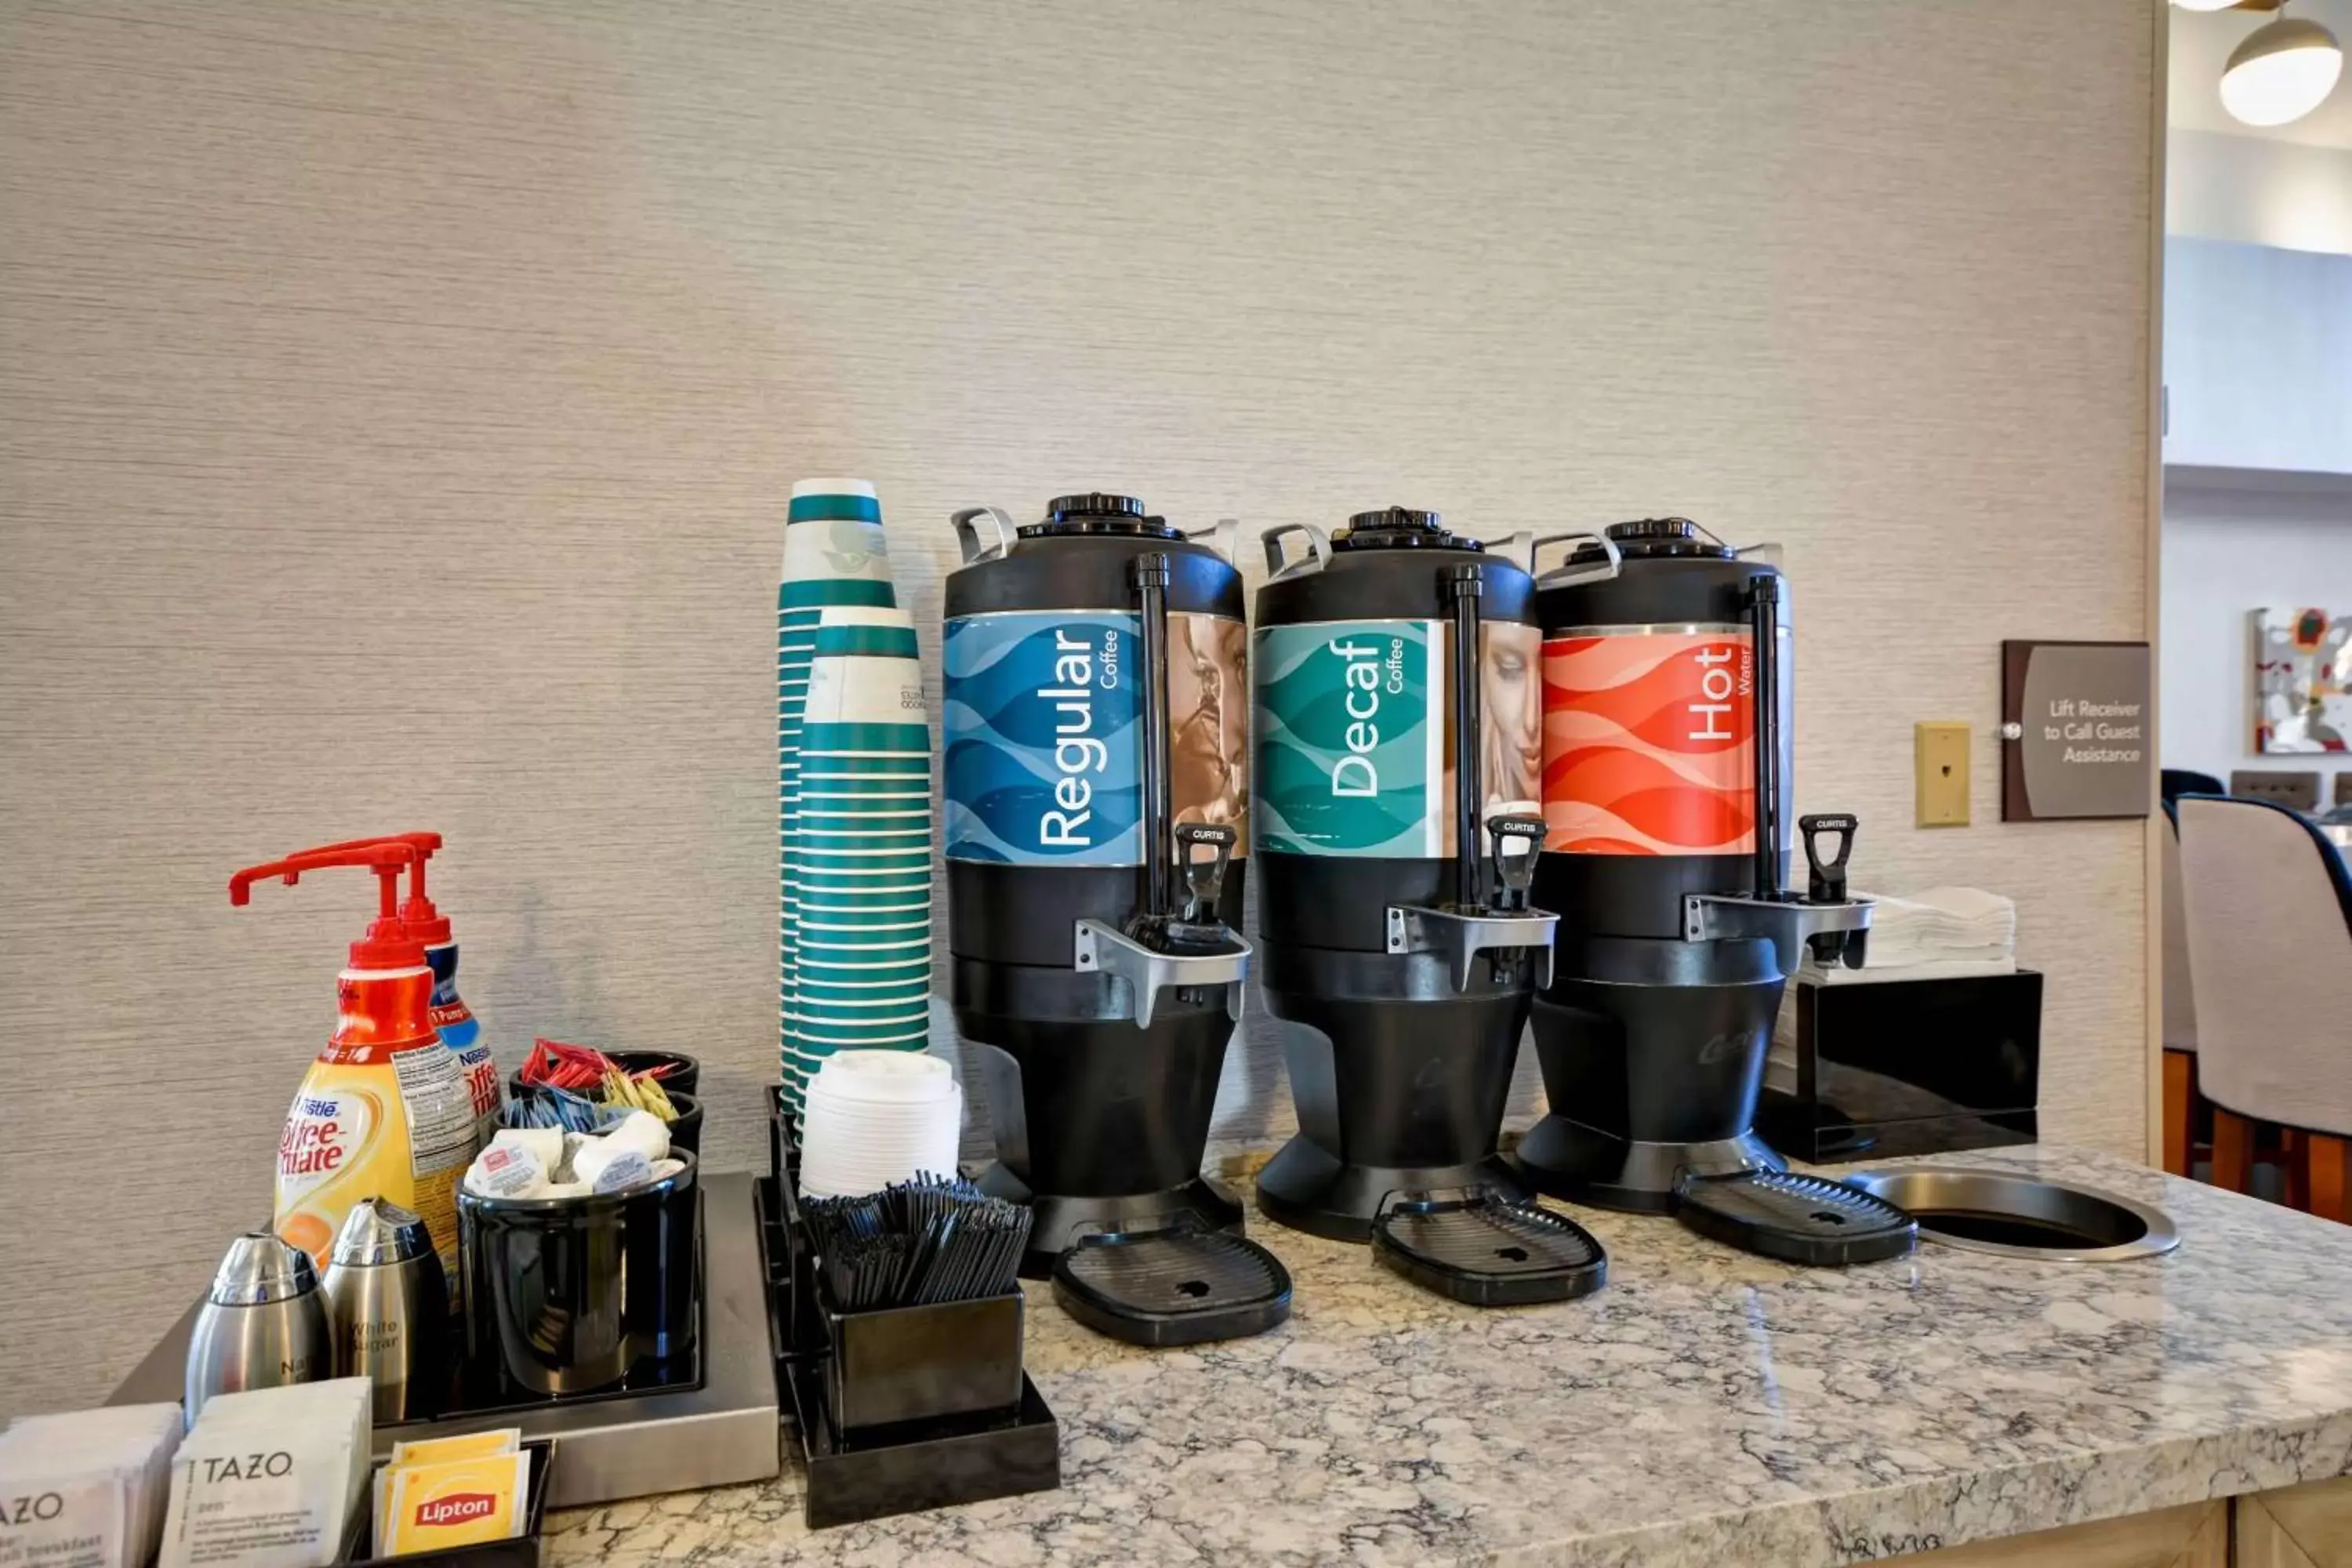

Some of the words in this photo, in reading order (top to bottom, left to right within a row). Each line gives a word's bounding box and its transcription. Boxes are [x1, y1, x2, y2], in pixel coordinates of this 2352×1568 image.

[1099, 630, 1118, 690] Coffee
[1386, 638, 1403, 695] Coffee
[1737, 648, 1751, 696] Water
[1688, 647, 1732, 740] Hot
[2049, 699, 2075, 717] Lift
[2078, 699, 2141, 717] Receiver
[1329, 639, 1379, 797] Decaf
[2044, 724, 2061, 741] to
[2063, 722, 2093, 740] Call
[2095, 722, 2141, 740] Guest
[1036, 630, 1108, 846] Regular
[2062, 745, 2141, 763] Assistance
[1192, 829, 1225, 840] CURTIS
[1504, 822, 1536, 833] CURTIS
[1817, 818, 1849, 829] CURTIS
[202, 1450, 293, 1484] TAZO
[0, 1491, 64, 1526] ZO
[422, 1499, 489, 1523] Lipton
